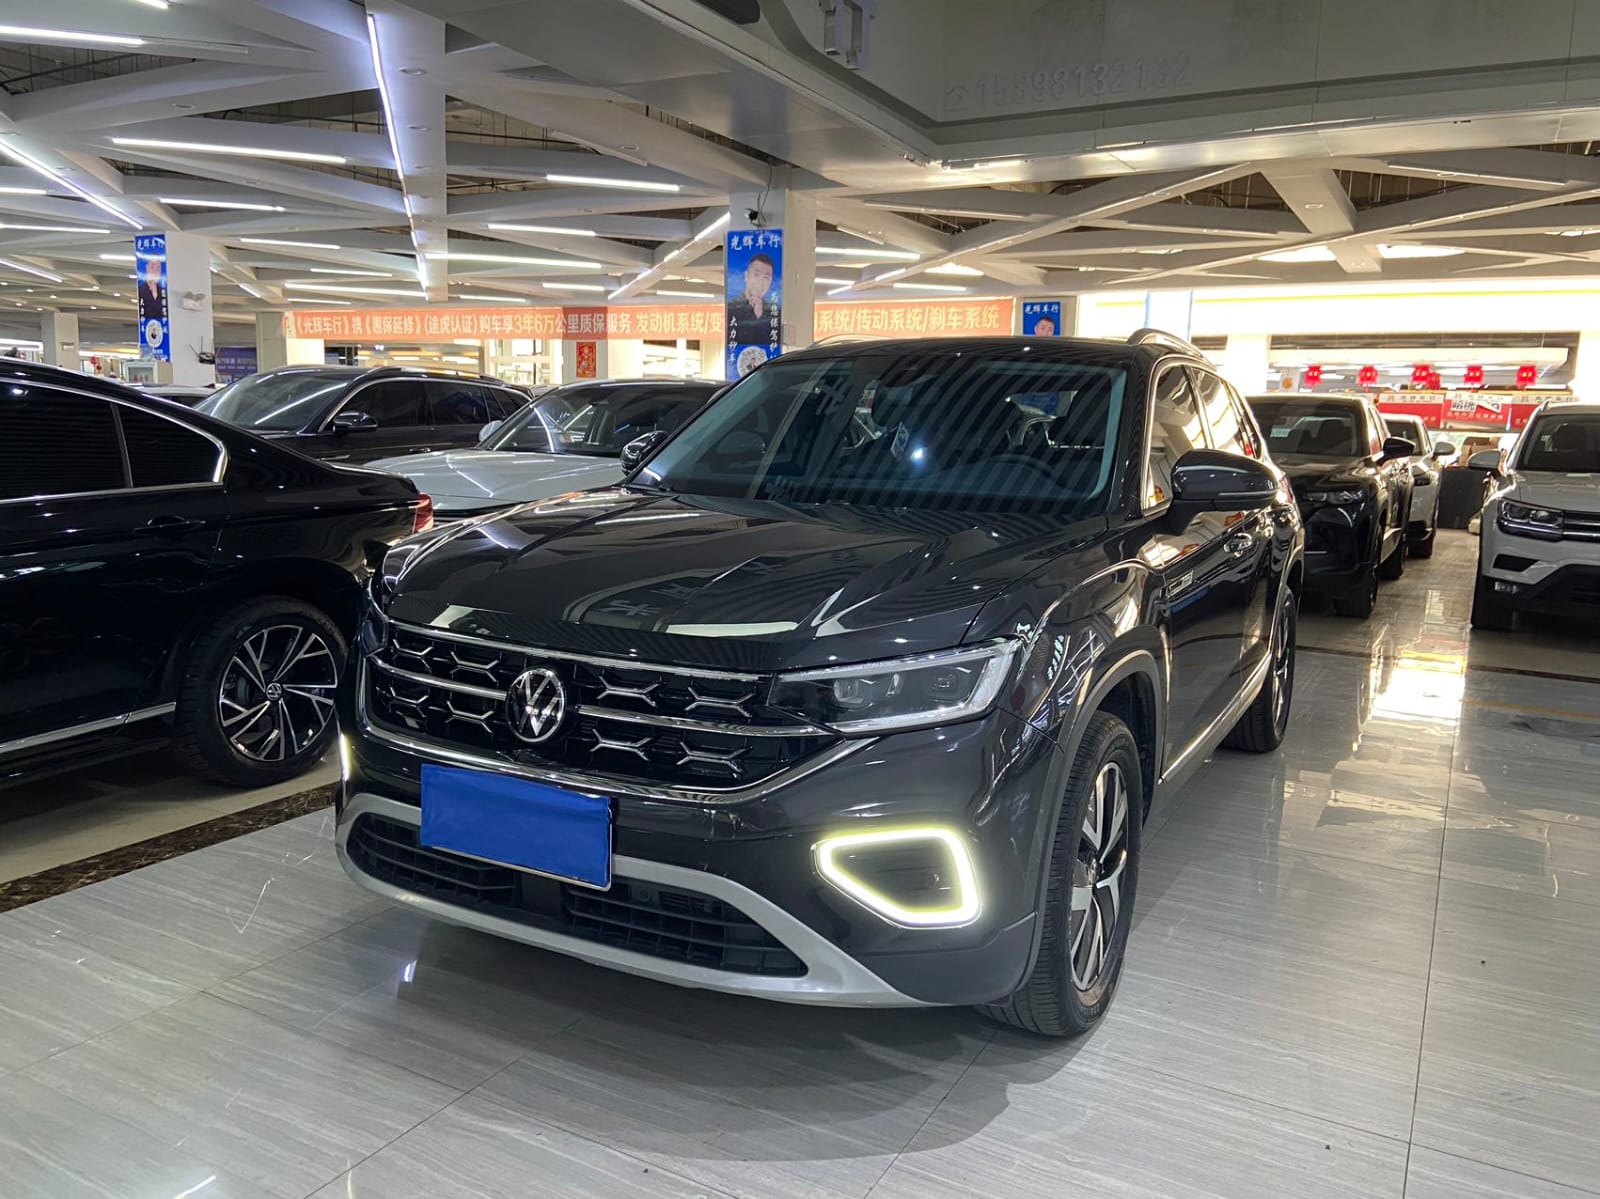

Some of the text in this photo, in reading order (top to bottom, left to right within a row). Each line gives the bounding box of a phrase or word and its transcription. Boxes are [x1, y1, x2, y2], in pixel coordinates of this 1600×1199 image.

[730, 234, 780, 250] 光辉车行
[1024, 303, 1060, 314] 光辉车行
[814, 304, 1000, 333] 系统/传动系统/刹车系统
